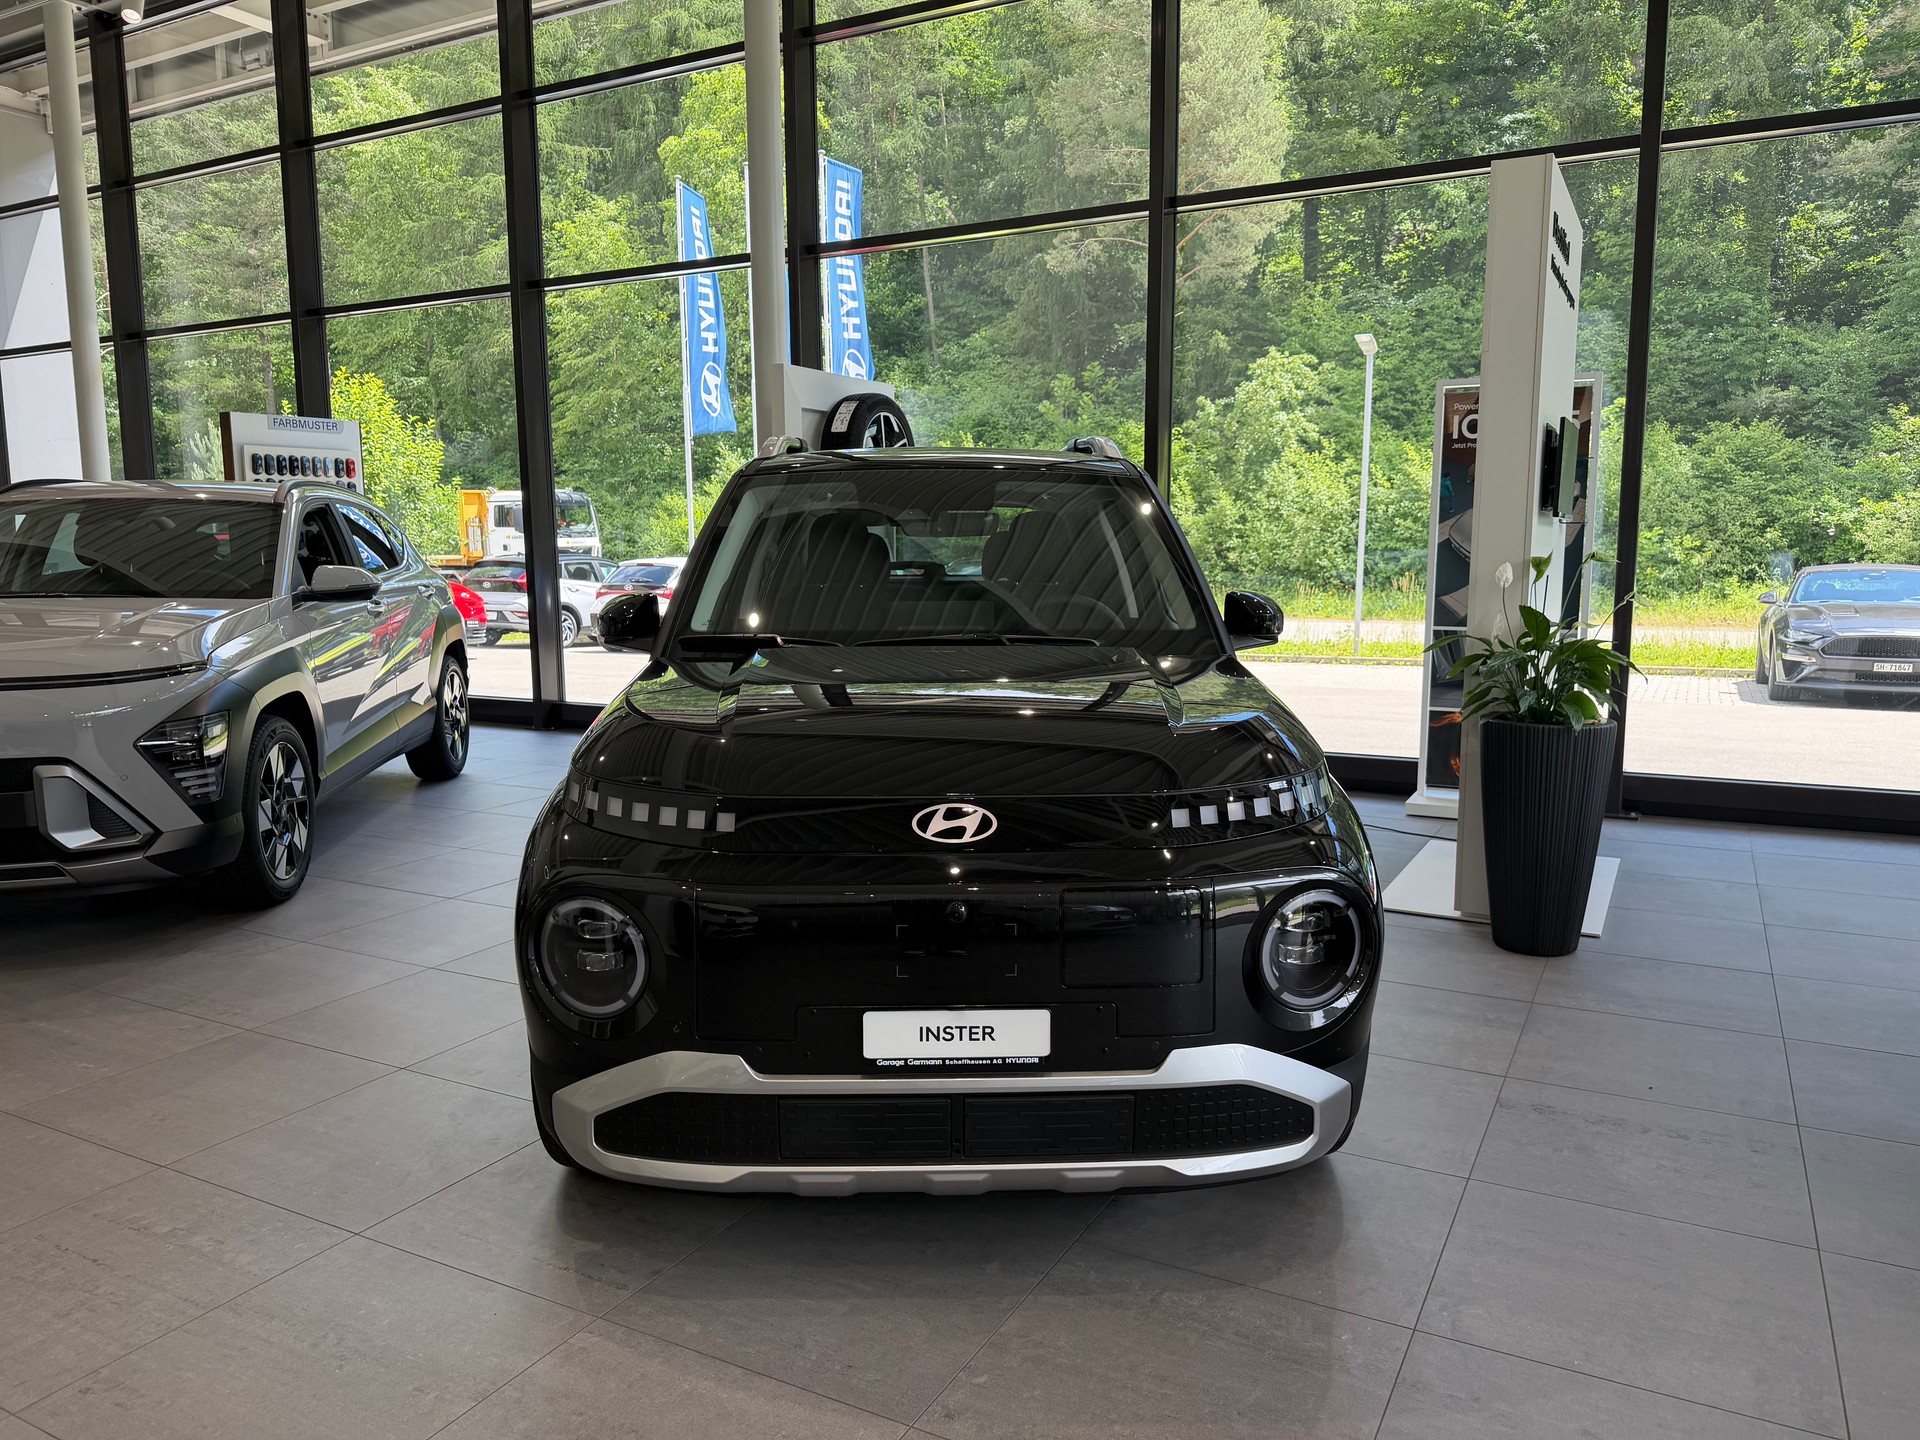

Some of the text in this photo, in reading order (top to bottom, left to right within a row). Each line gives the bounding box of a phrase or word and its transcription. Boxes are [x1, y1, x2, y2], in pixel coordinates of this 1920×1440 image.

[273, 418, 338, 431] FARBMUSTER
[919, 1025, 996, 1042] INSTER
[876, 1059, 905, 1067] Garage
